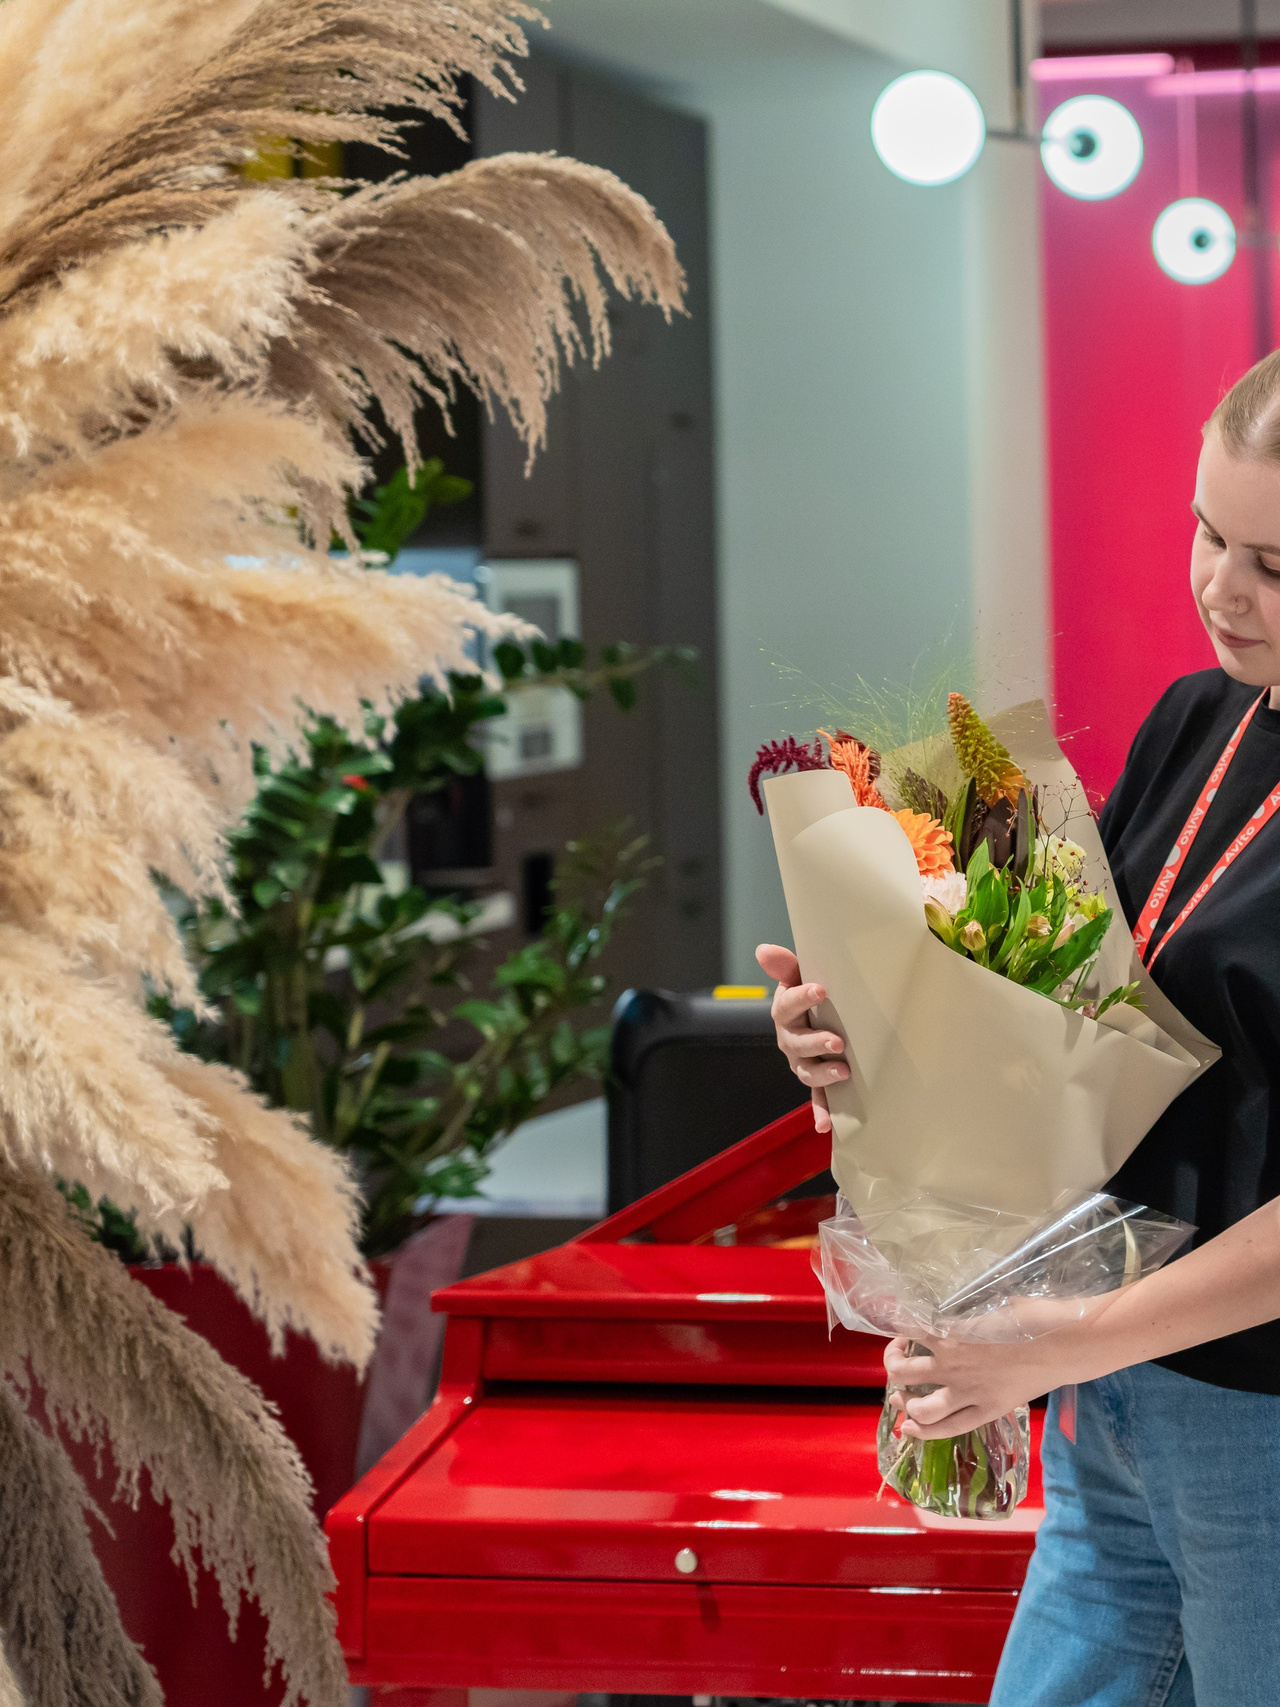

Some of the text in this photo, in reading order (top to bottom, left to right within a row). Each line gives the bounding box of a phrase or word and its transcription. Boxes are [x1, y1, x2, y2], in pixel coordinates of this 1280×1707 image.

[1149, 745, 1234, 908] Avito Avito Avito
[1181, 883, 1209, 919] Avito
[1225, 826, 1255, 862] Avito
